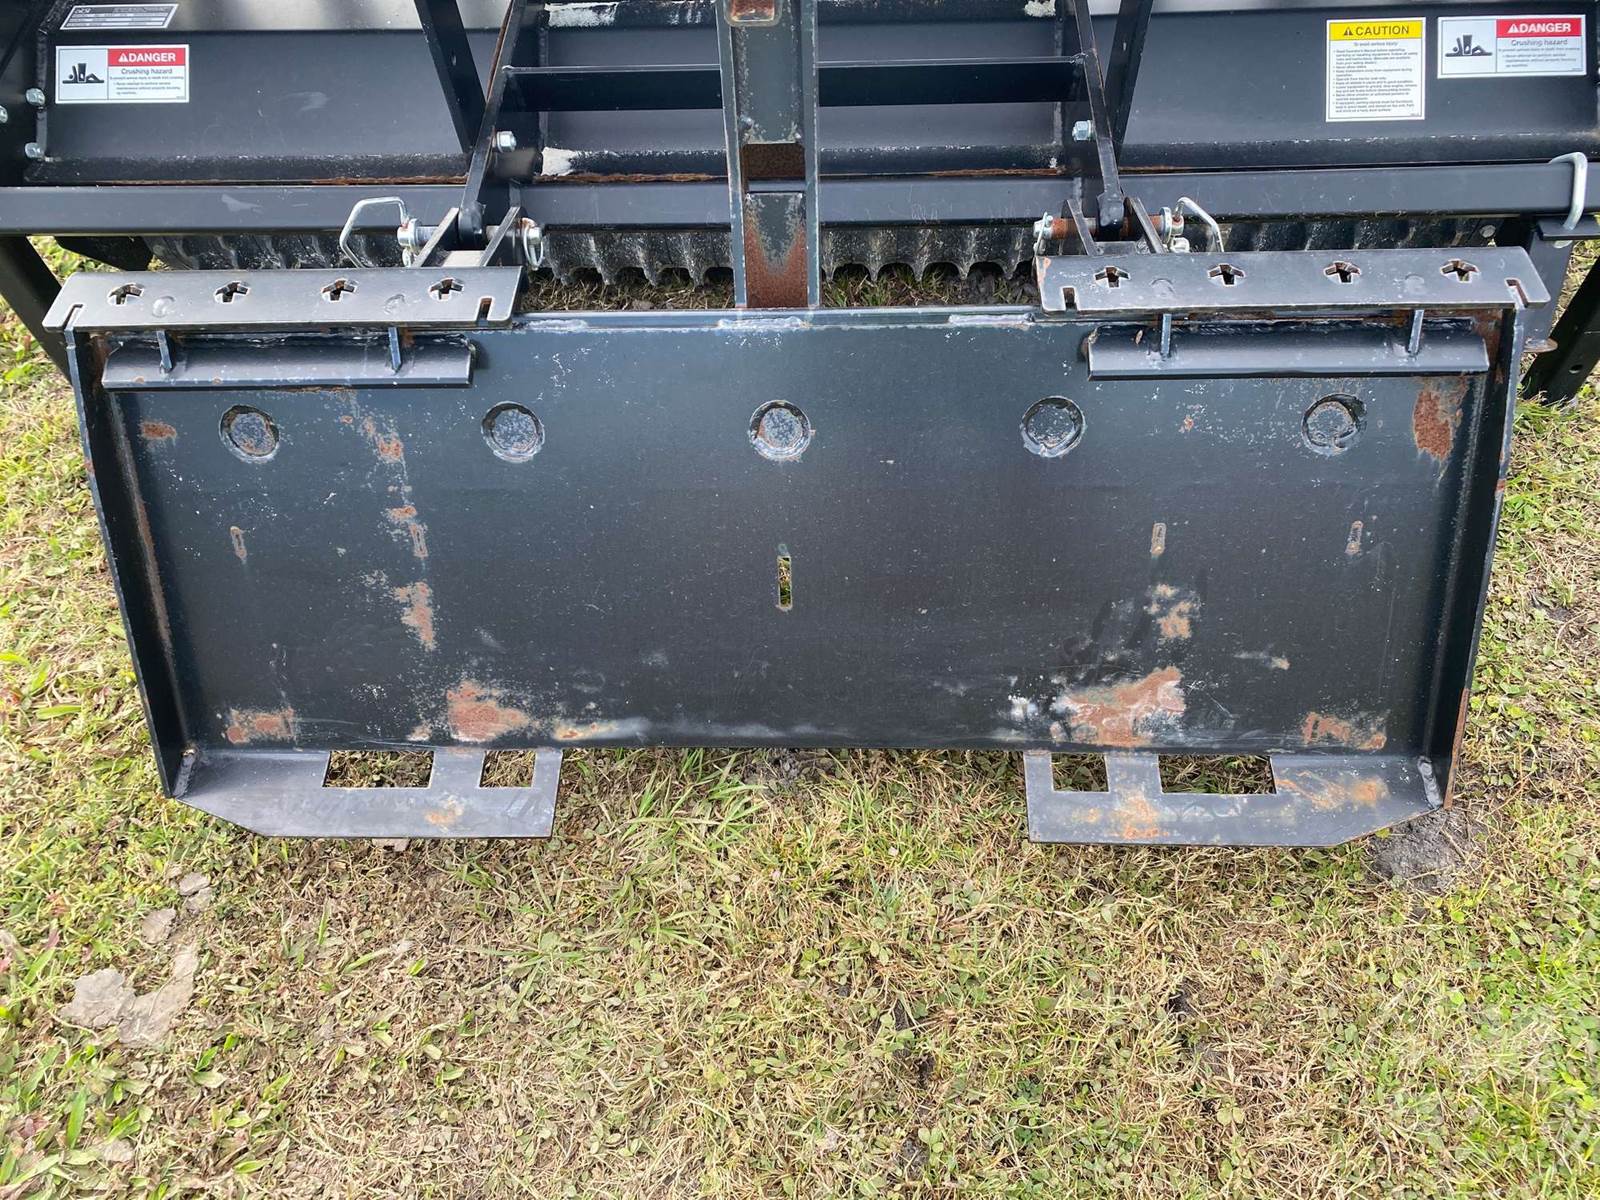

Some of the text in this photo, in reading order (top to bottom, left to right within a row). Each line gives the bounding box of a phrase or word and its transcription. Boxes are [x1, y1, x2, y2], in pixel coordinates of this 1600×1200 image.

[1355, 25, 1409, 36] CAUTION
[1519, 22, 1571, 33] DANGER
[128, 52, 176, 62] DANGER
